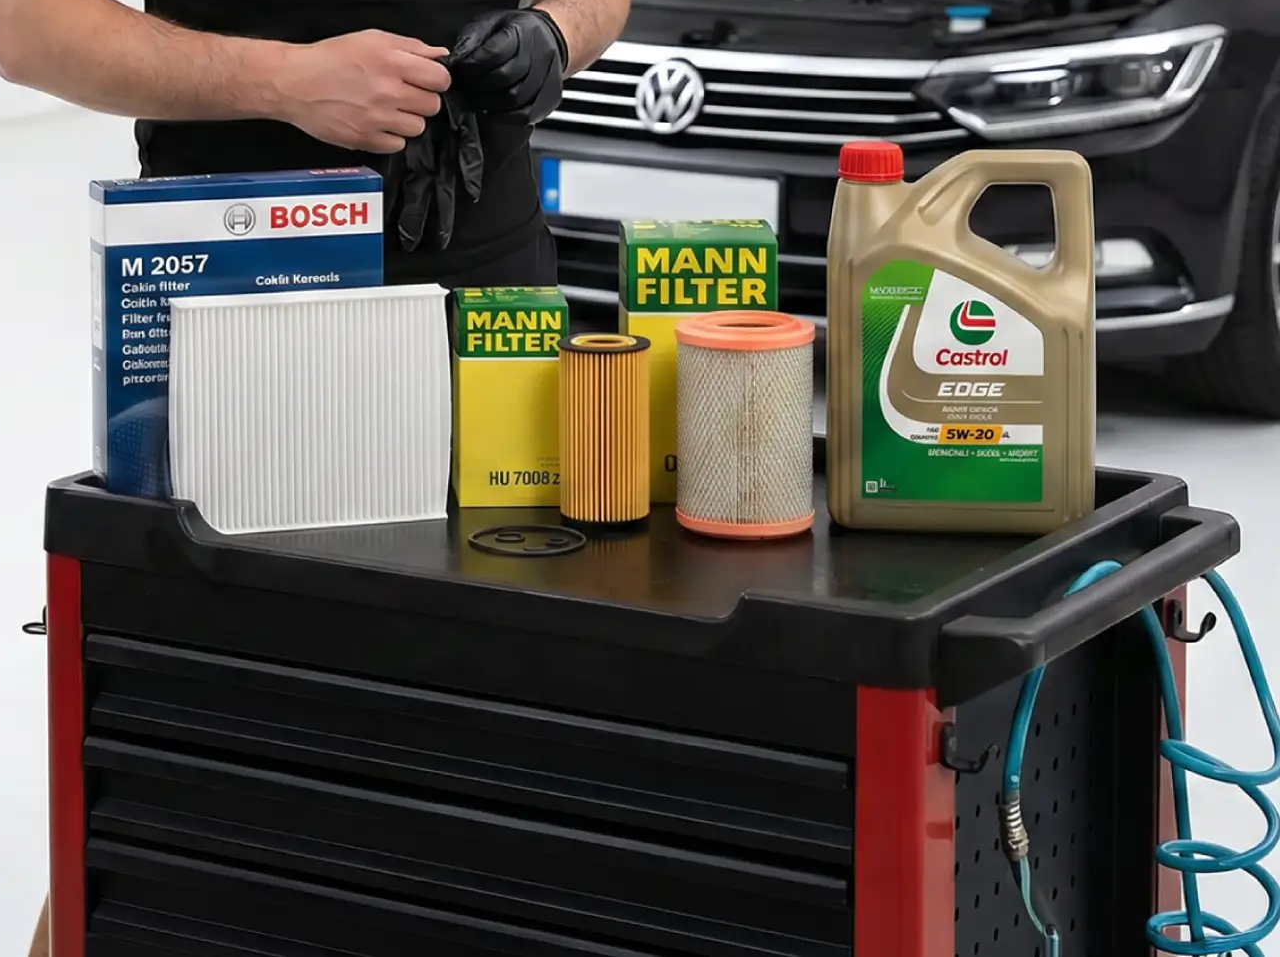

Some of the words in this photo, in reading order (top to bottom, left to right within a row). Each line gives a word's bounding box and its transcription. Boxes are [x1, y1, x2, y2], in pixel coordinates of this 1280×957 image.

[270, 201, 369, 229] BOSCH
[121, 258, 143, 277] M
[150, 254, 209, 275] 2057
[636, 247, 767, 274] MANN
[637, 277, 767, 305] FILTER
[467, 310, 562, 331] MANN
[467, 332, 562, 352] FILTER
[935, 348, 1009, 367] Castrol
[937, 382, 1007, 397] EDGE
[946, 428, 995, 440] 5W-20
[489, 471, 510, 485] HU
[513, 470, 550, 485] 7008
